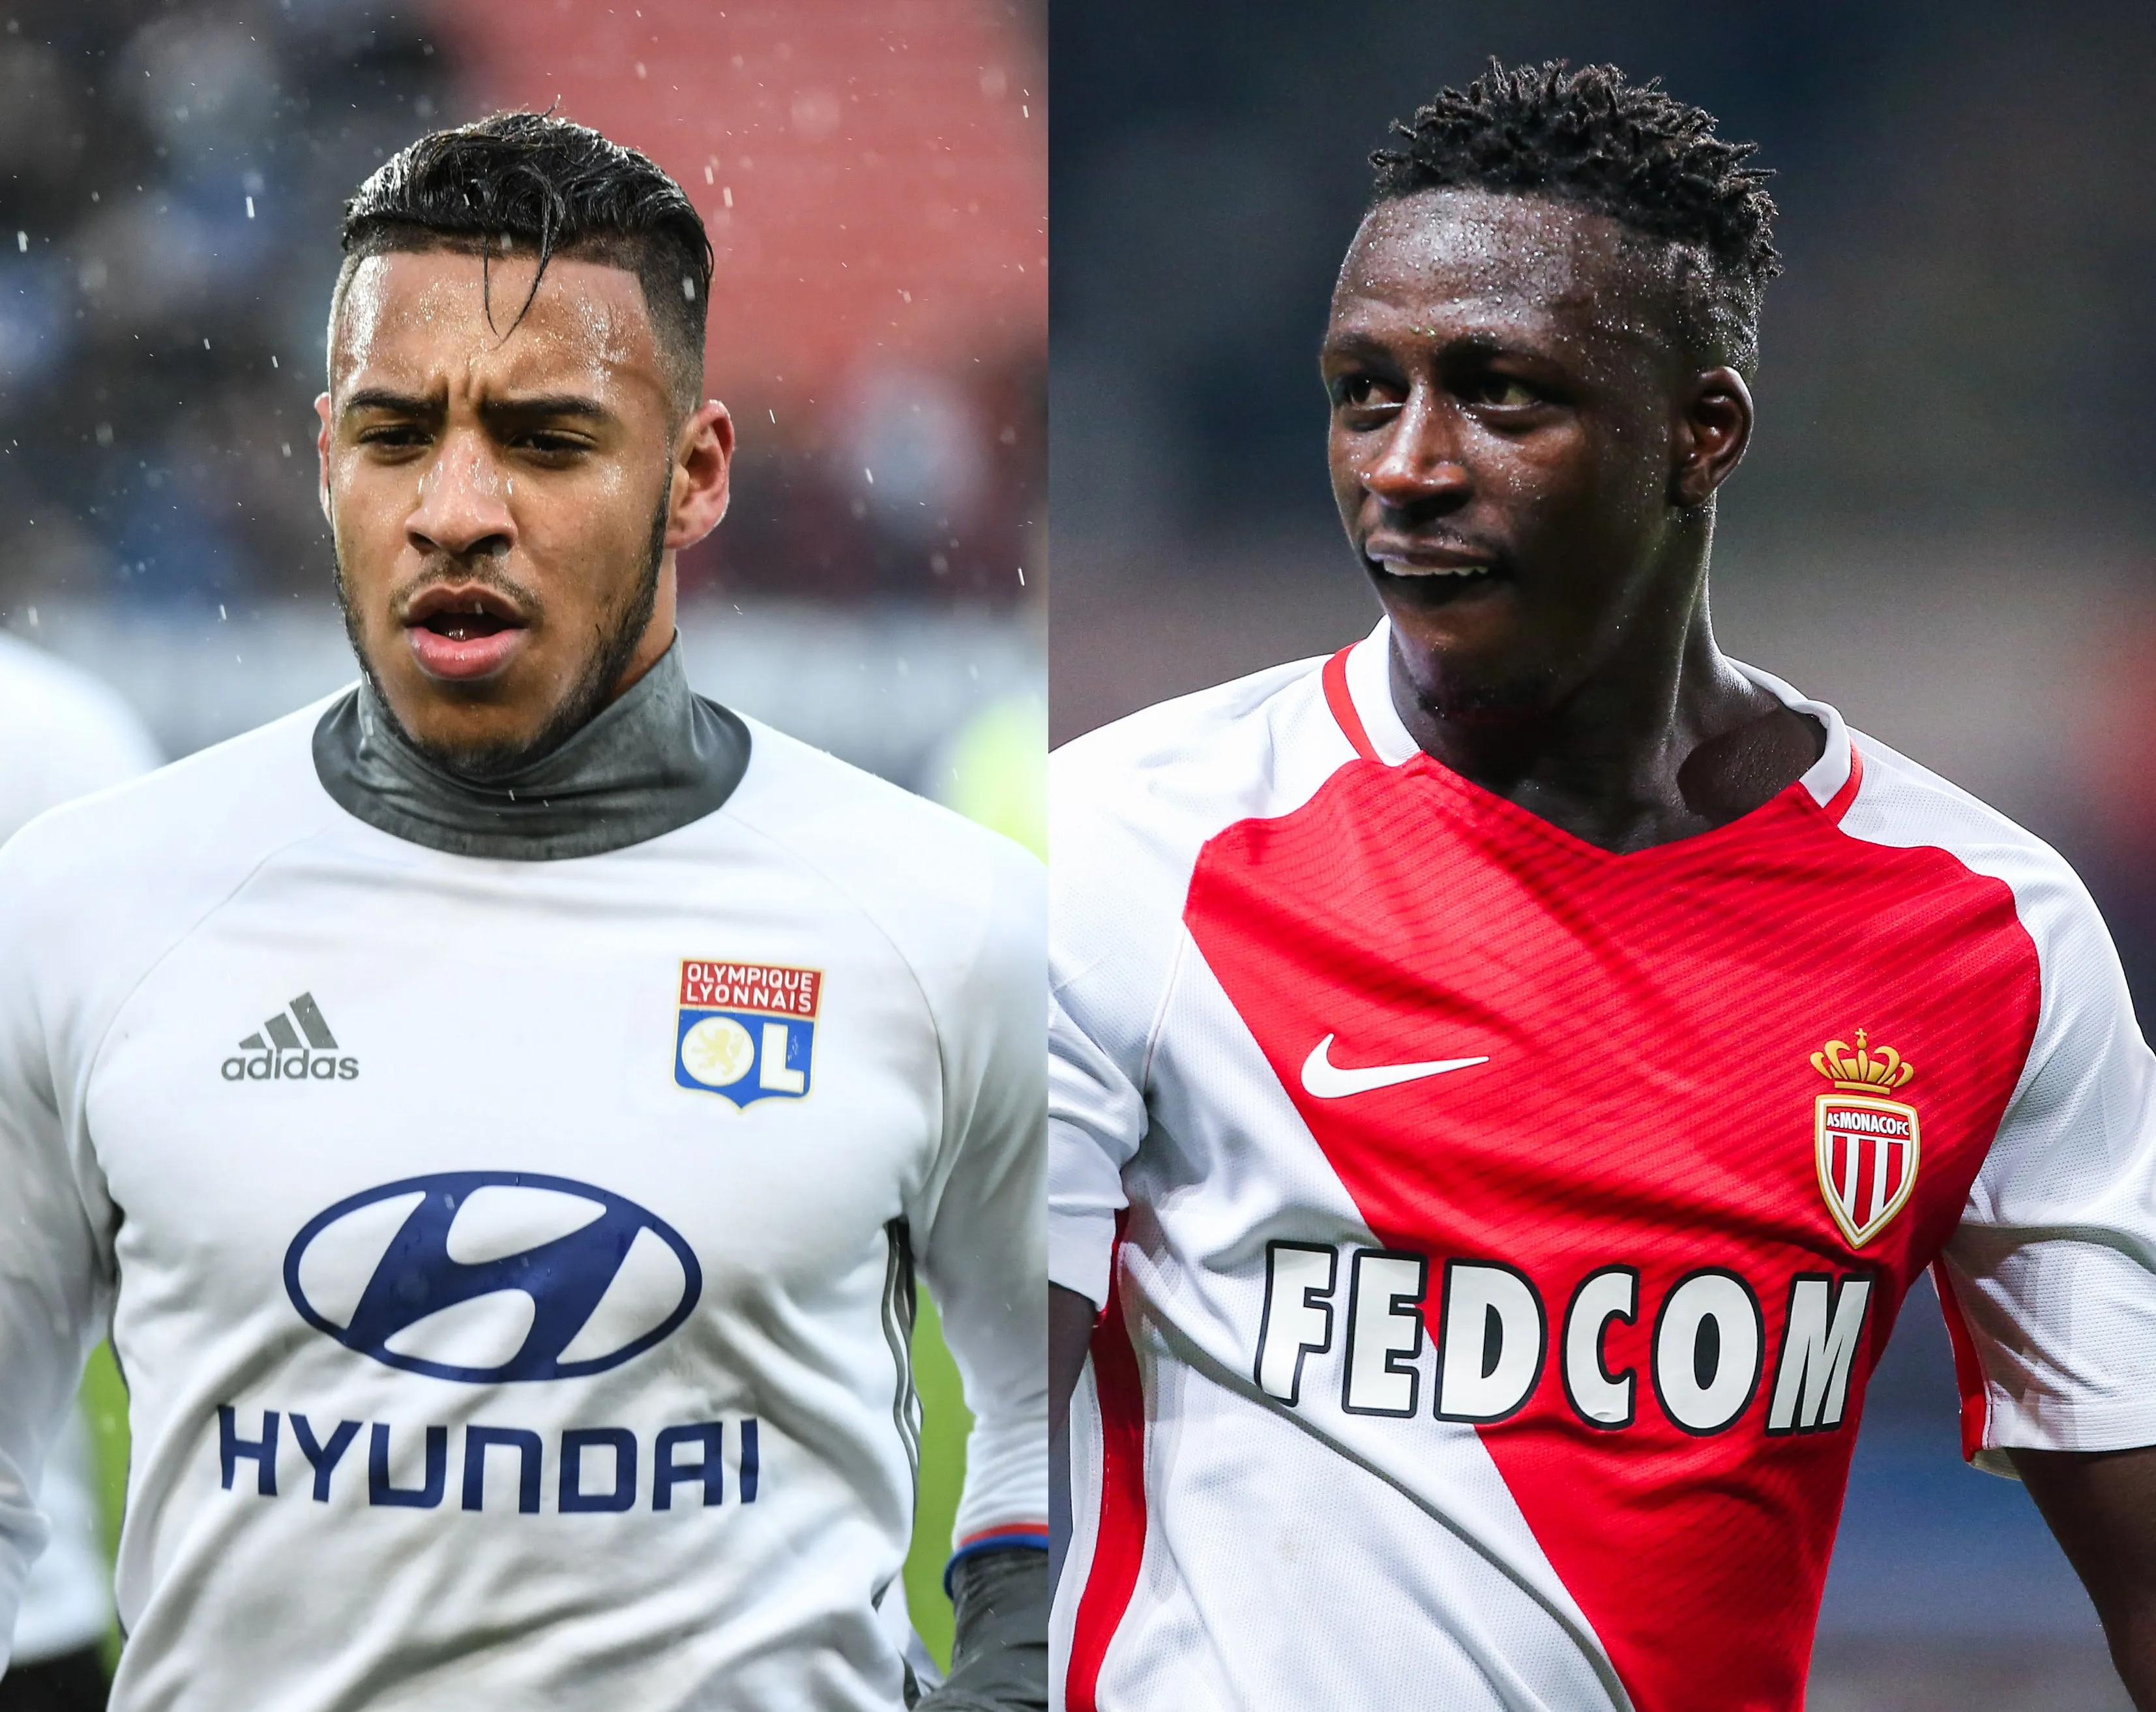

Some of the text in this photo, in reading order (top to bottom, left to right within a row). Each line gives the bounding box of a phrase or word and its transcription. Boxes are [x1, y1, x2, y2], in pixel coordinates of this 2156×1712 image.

[687, 963, 814, 992] OLYMPIQUE
[687, 982, 812, 1012] LYONNAIS
[221, 1048, 359, 1082] adidas
[681, 1016, 805, 1094] OL
[1254, 1240, 1874, 1436] FEDCOM
[218, 1404, 759, 1514] HYUNDAI
